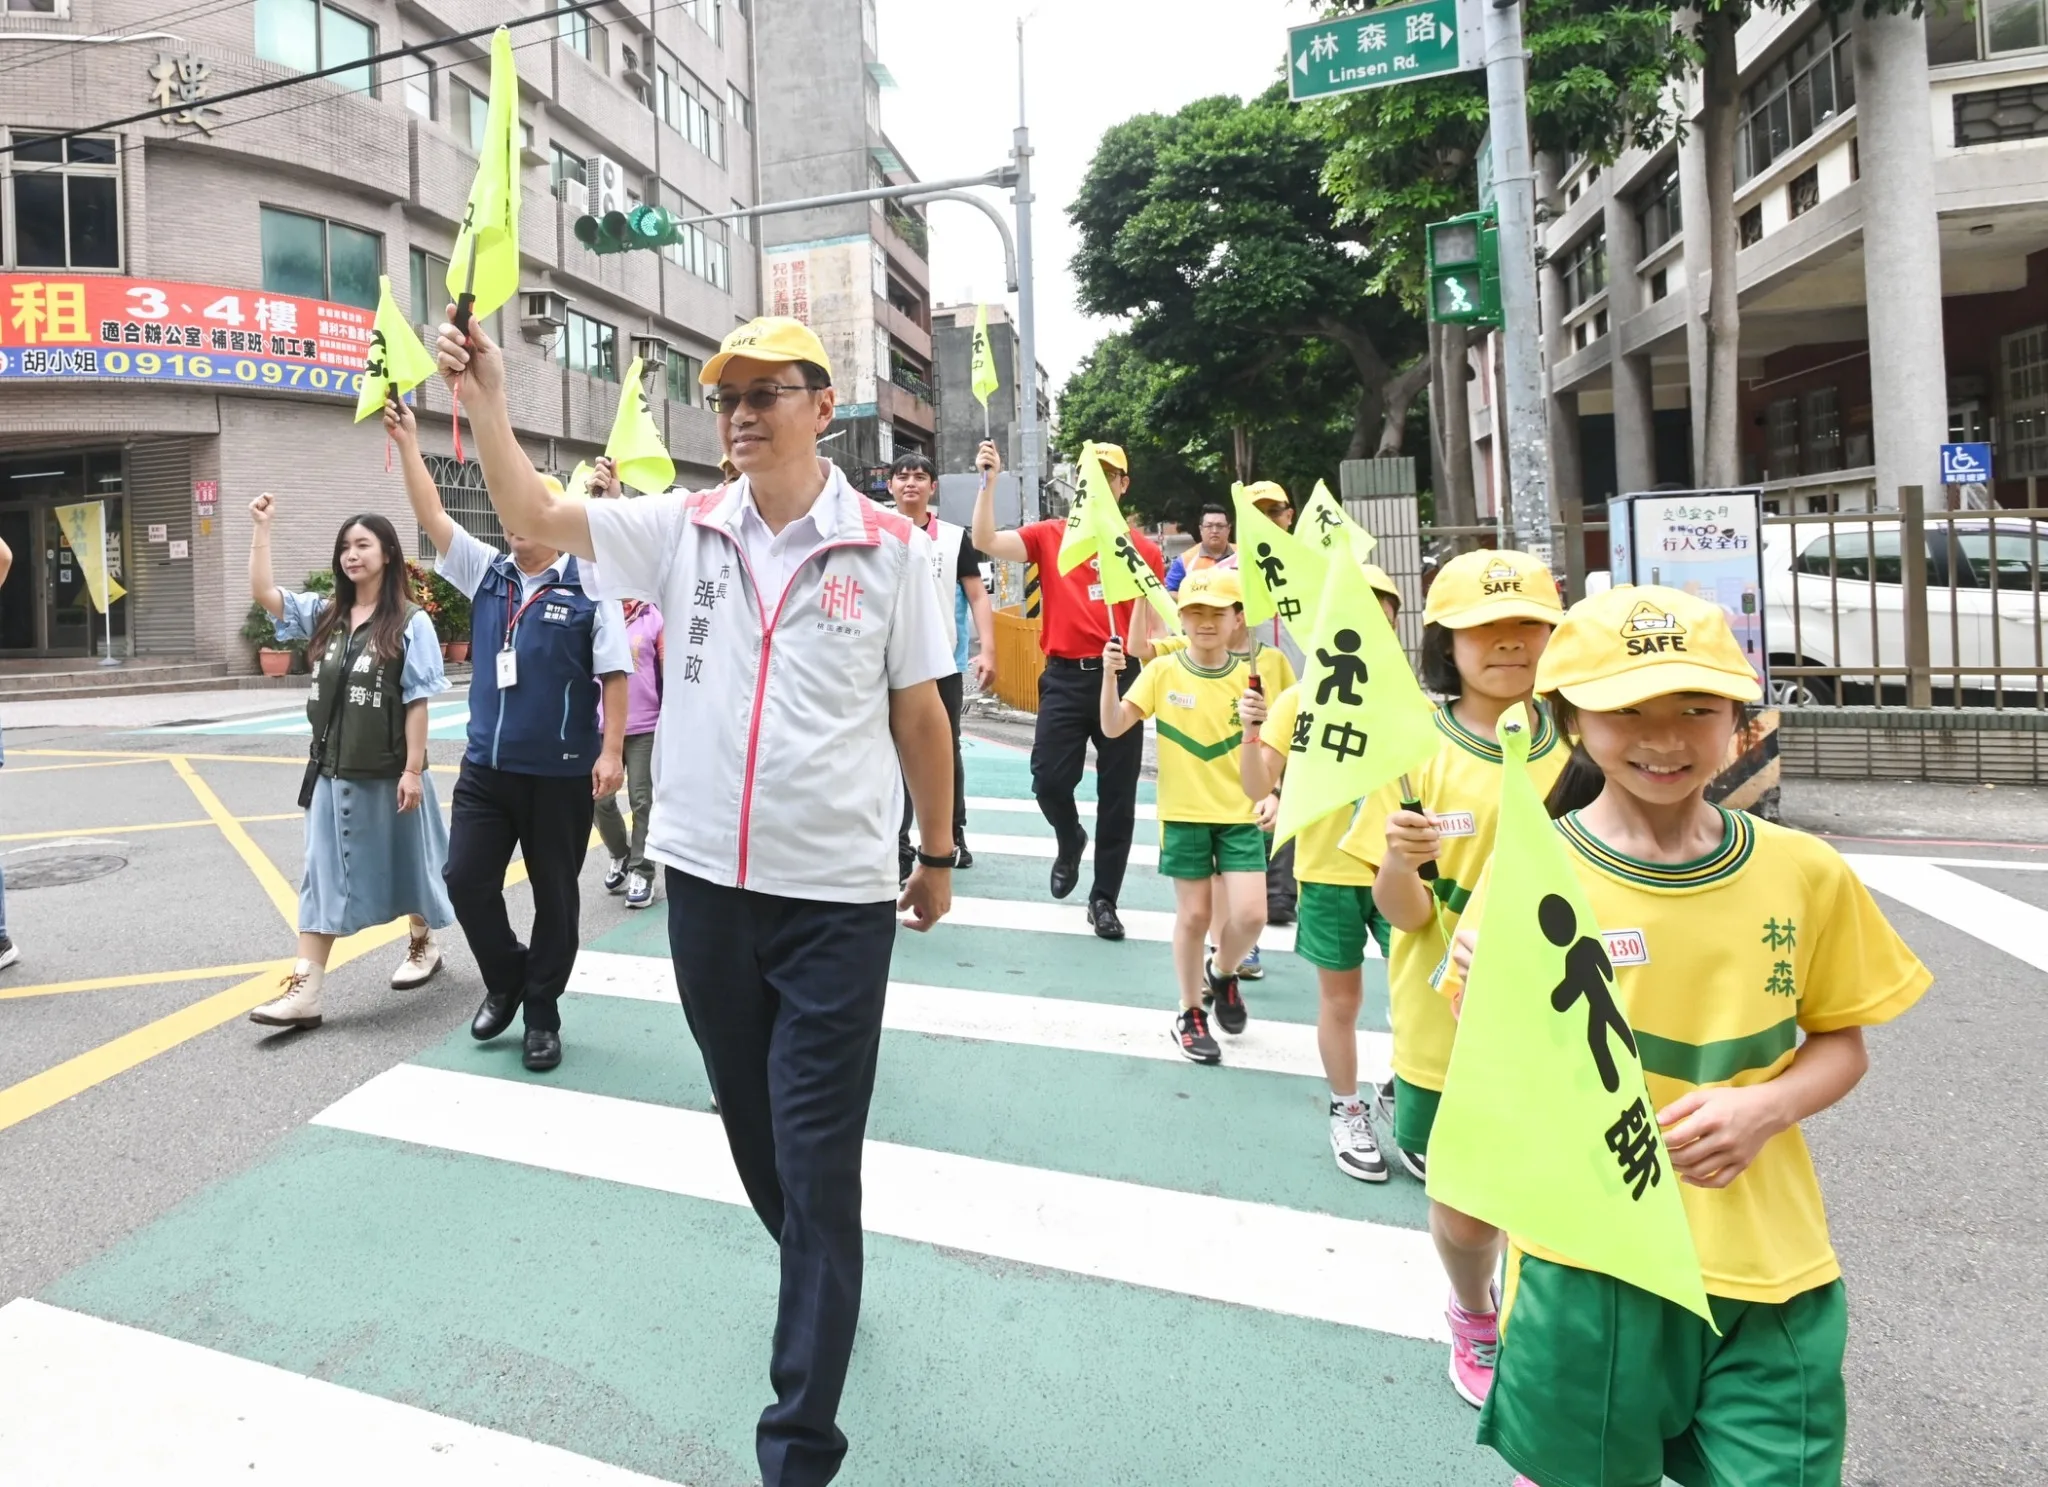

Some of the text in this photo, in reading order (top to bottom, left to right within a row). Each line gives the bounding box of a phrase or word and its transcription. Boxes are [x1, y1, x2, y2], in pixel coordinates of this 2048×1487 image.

[1310, 12, 1437, 63] 林森路
[1328, 54, 1419, 84] Linsen Rd.
[148, 51, 223, 137] 樓
[11, 281, 92, 344] 租
[125, 286, 298, 334] 3、4樓
[23, 351, 98, 373] 胡小姐
[104, 351, 363, 396] 0916-097076
[1067, 514, 1081, 531] 中
[1663, 536, 1749, 551] 行人安全行
[716, 564, 730, 599] 市長
[1484, 582, 1522, 595] SAFE
[1277, 596, 1302, 623] 中
[684, 579, 716, 684] 張善政
[1627, 635, 1687, 656] SAFE
[1762, 917, 1796, 998] 林森
